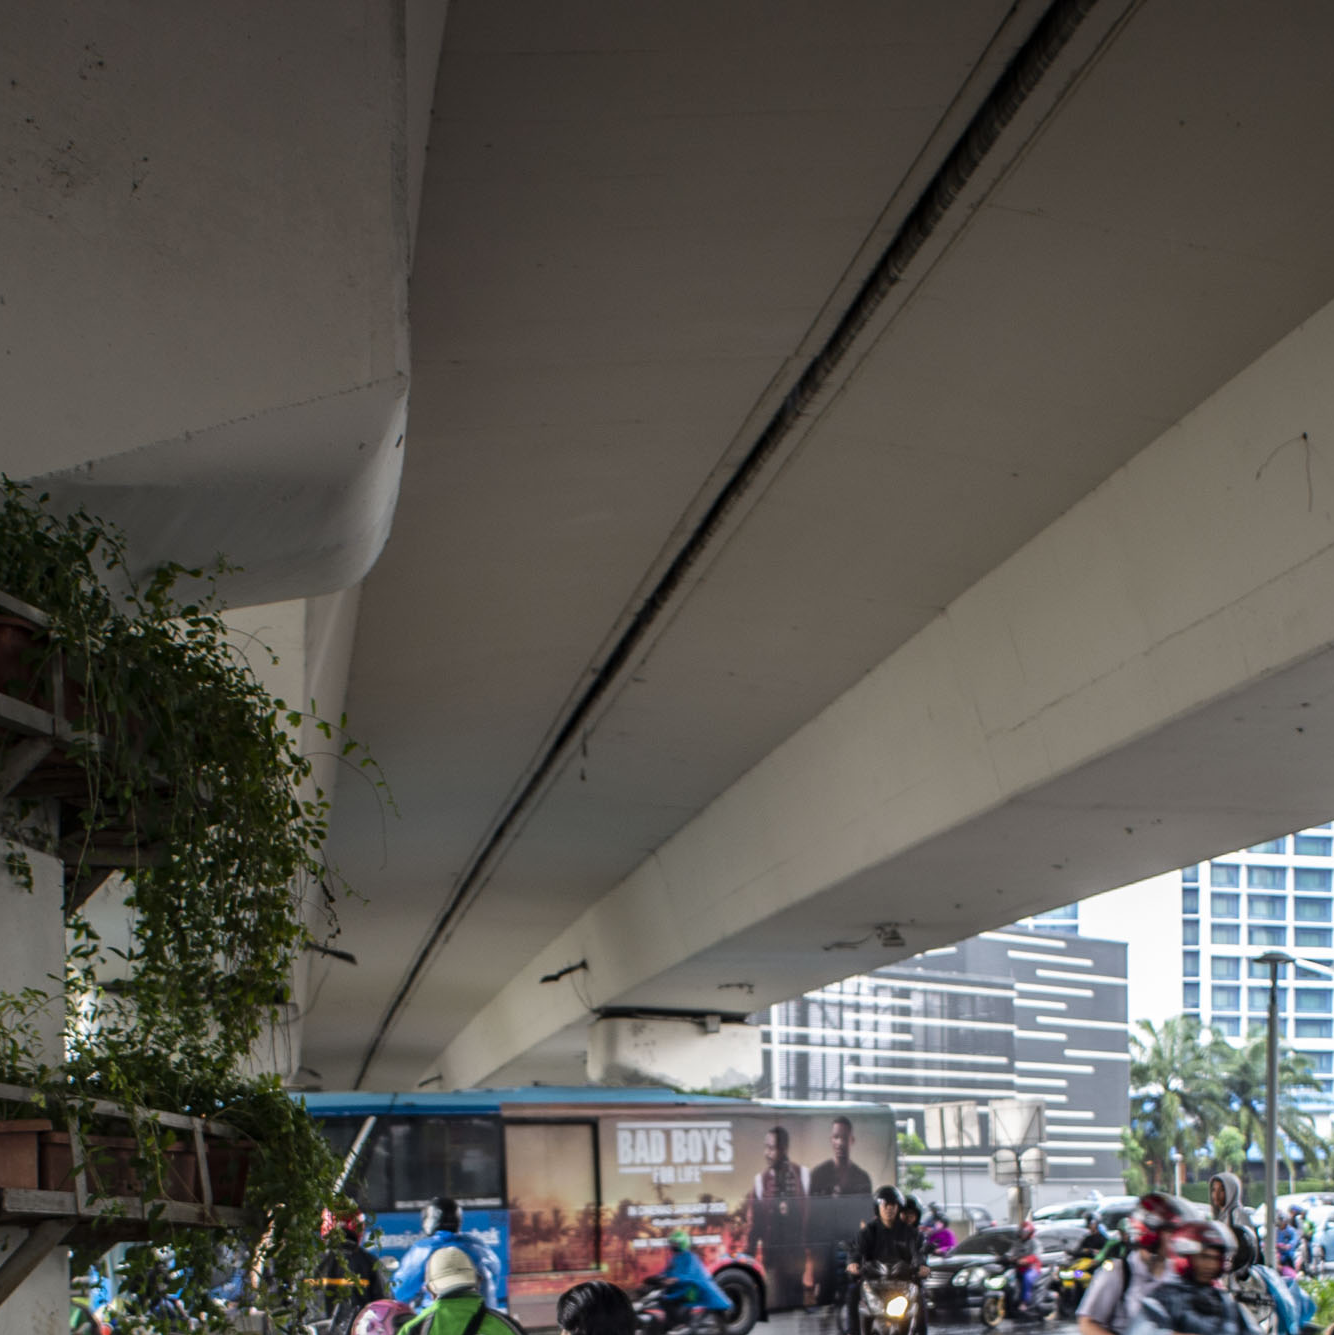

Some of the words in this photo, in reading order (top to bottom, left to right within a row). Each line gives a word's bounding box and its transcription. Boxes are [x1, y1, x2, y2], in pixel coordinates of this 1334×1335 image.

[617, 1129, 666, 1164] BAD
[671, 1129, 733, 1163] BOYS
[652, 1166, 675, 1184] FOR
[677, 1166, 701, 1184] LIFE
